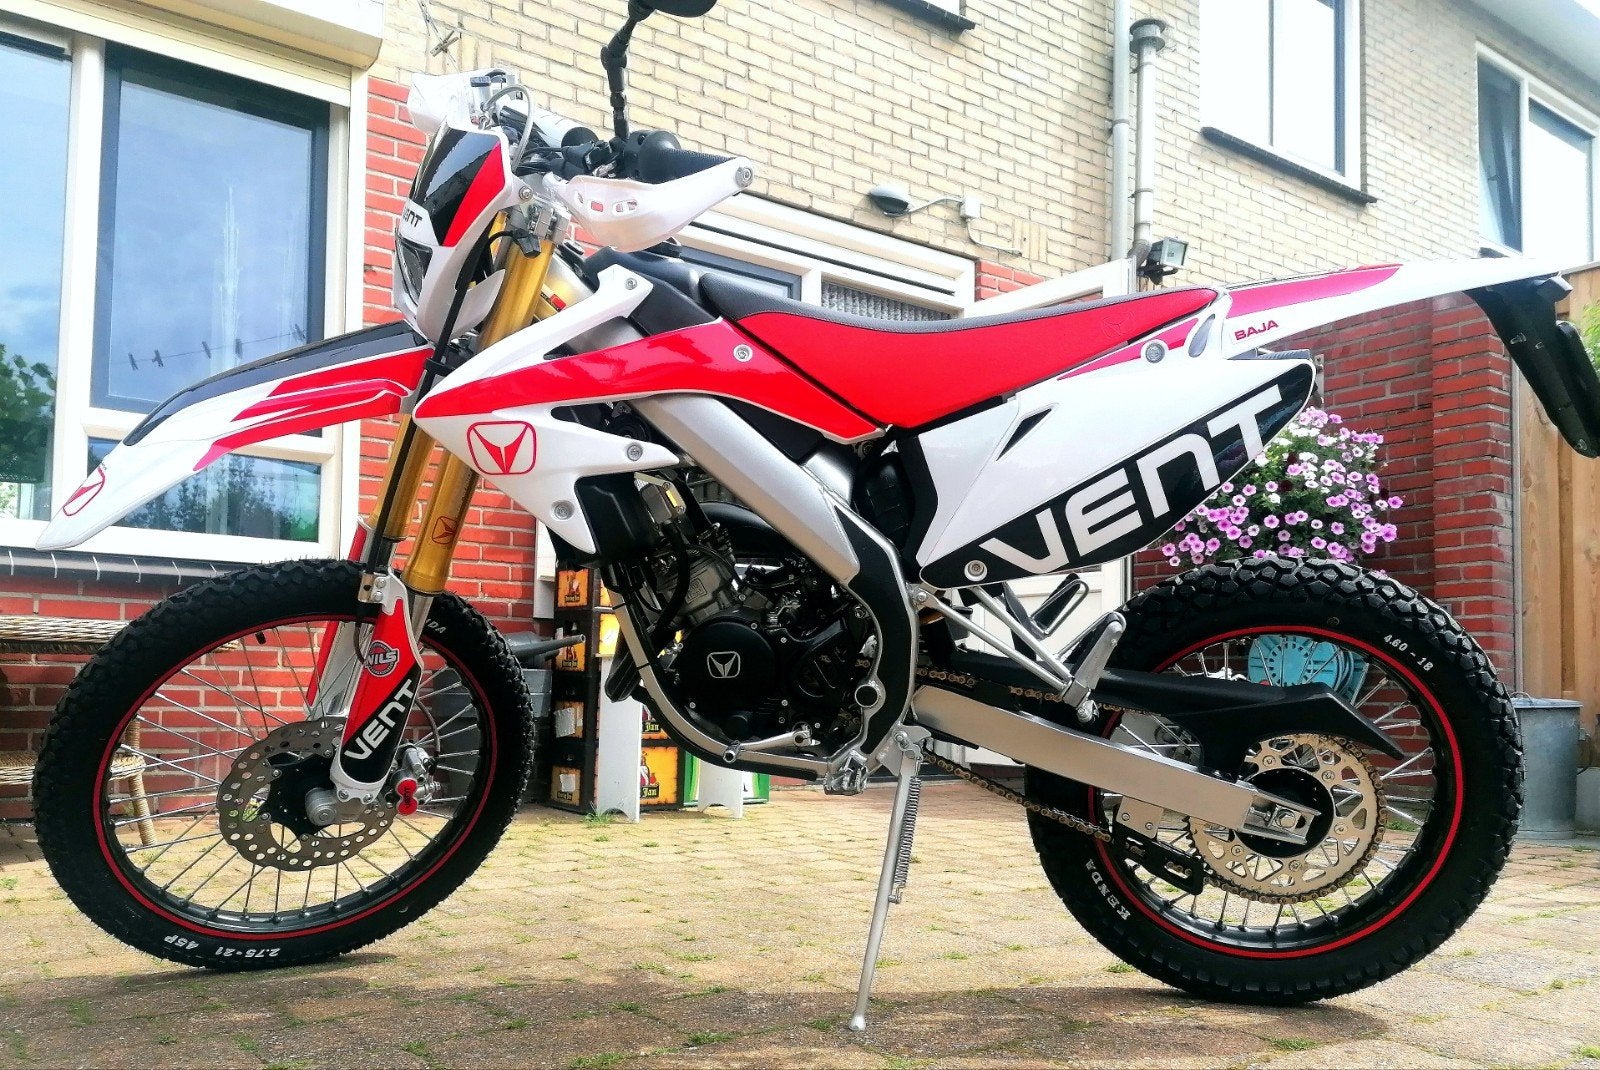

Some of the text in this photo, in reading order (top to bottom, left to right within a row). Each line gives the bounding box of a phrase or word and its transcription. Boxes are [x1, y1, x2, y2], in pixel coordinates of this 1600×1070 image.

[1234, 319, 1279, 340] BAJA
[979, 384, 1282, 574] VENT
[1383, 634, 1409, 651] 4.60
[343, 678, 415, 761] VENT
[644, 722, 660, 732] Jan
[642, 787, 657, 798] Jan
[1085, 858, 1131, 921] KENDA
